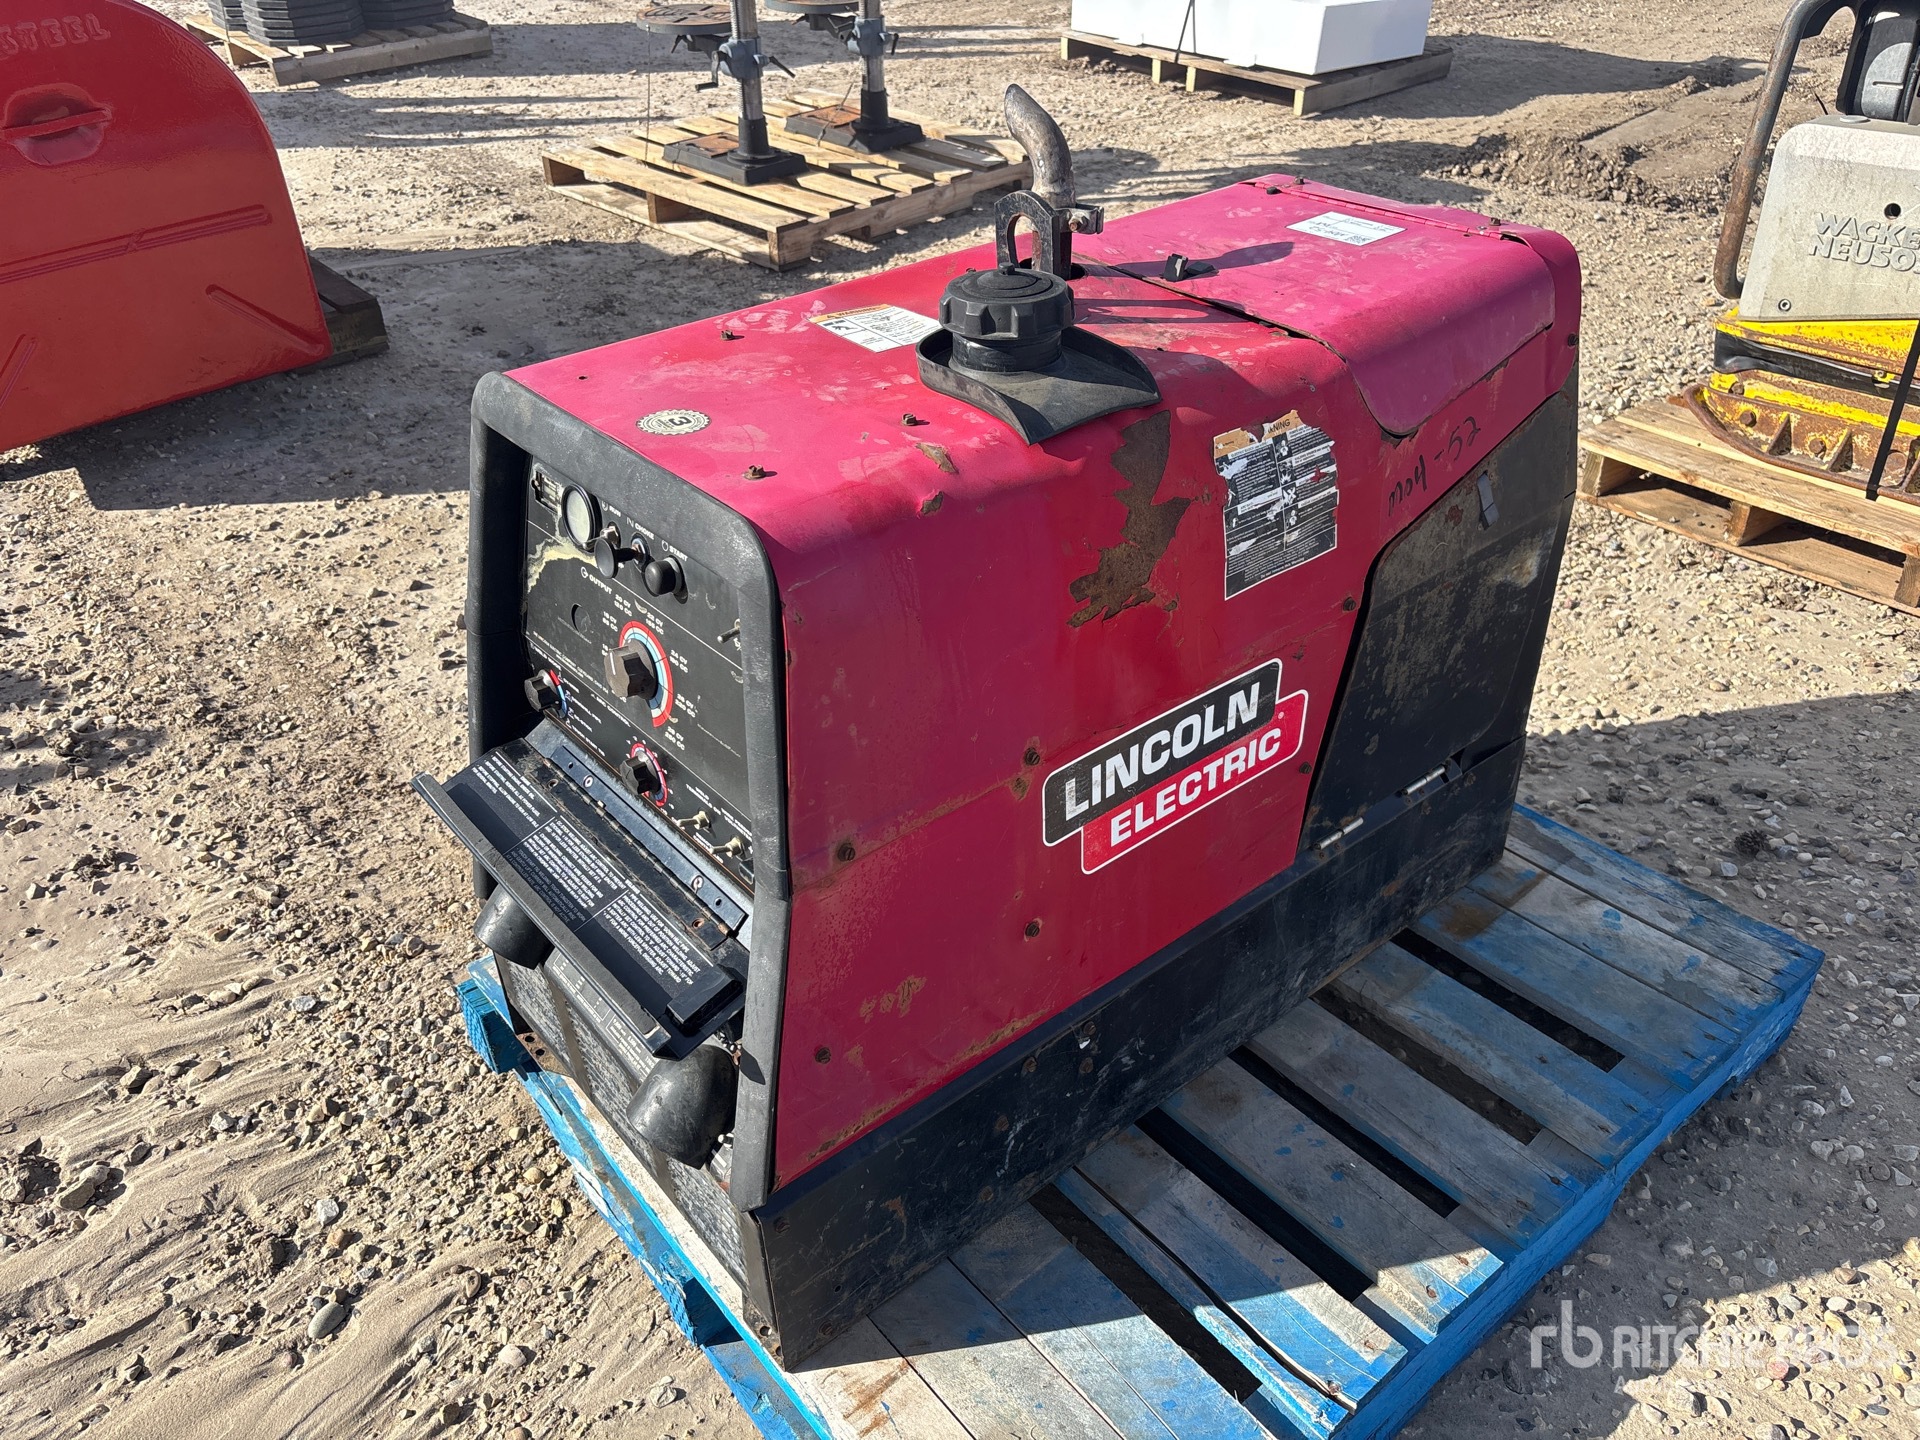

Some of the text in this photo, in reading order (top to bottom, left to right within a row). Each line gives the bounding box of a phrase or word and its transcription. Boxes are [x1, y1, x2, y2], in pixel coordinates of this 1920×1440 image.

[1809, 234, 1920, 274] NEUSO
[634, 523, 655, 540] CHOKE
[669, 545, 688, 562] START
[588, 575, 612, 595] OUTPUT
[1064, 681, 1260, 821] LINCOLN
[1109, 727, 1281, 848] ELECTRIC
